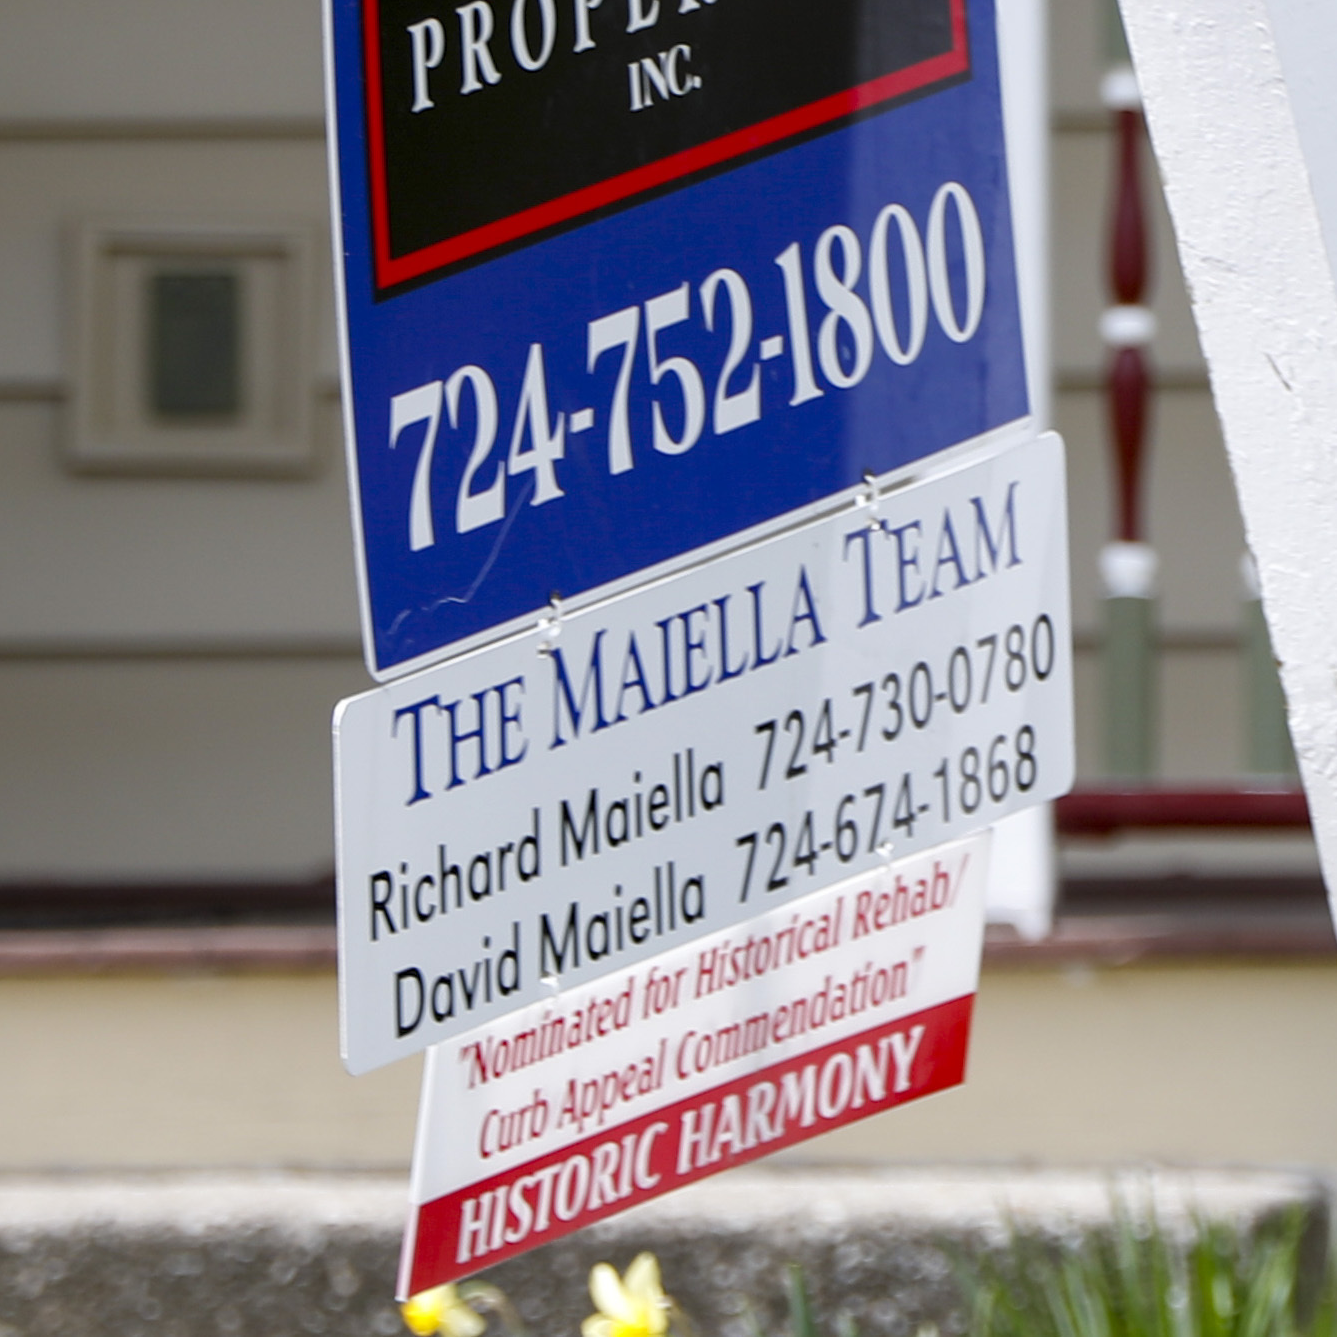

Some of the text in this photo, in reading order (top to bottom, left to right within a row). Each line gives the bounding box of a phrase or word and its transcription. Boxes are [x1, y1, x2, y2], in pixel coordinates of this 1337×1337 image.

[627, 44, 702, 111] INC.
[388, 181, 986, 553] 724-752-1800
[369, 613, 1055, 942] Richard Maiella 724-730-0780
[391, 481, 1023, 806] THE MAIELLA TEAM
[395, 724, 1038, 1039] David Maiella 724-674-1868
[459, 975, 636, 1090] "Nominated
[642, 966, 688, 1020] for
[694, 896, 844, 999] Historical
[455, 1025, 927, 1264] HISTORIC HARMONY
[480, 946, 926, 1159] Curb Appeal Commendation"
